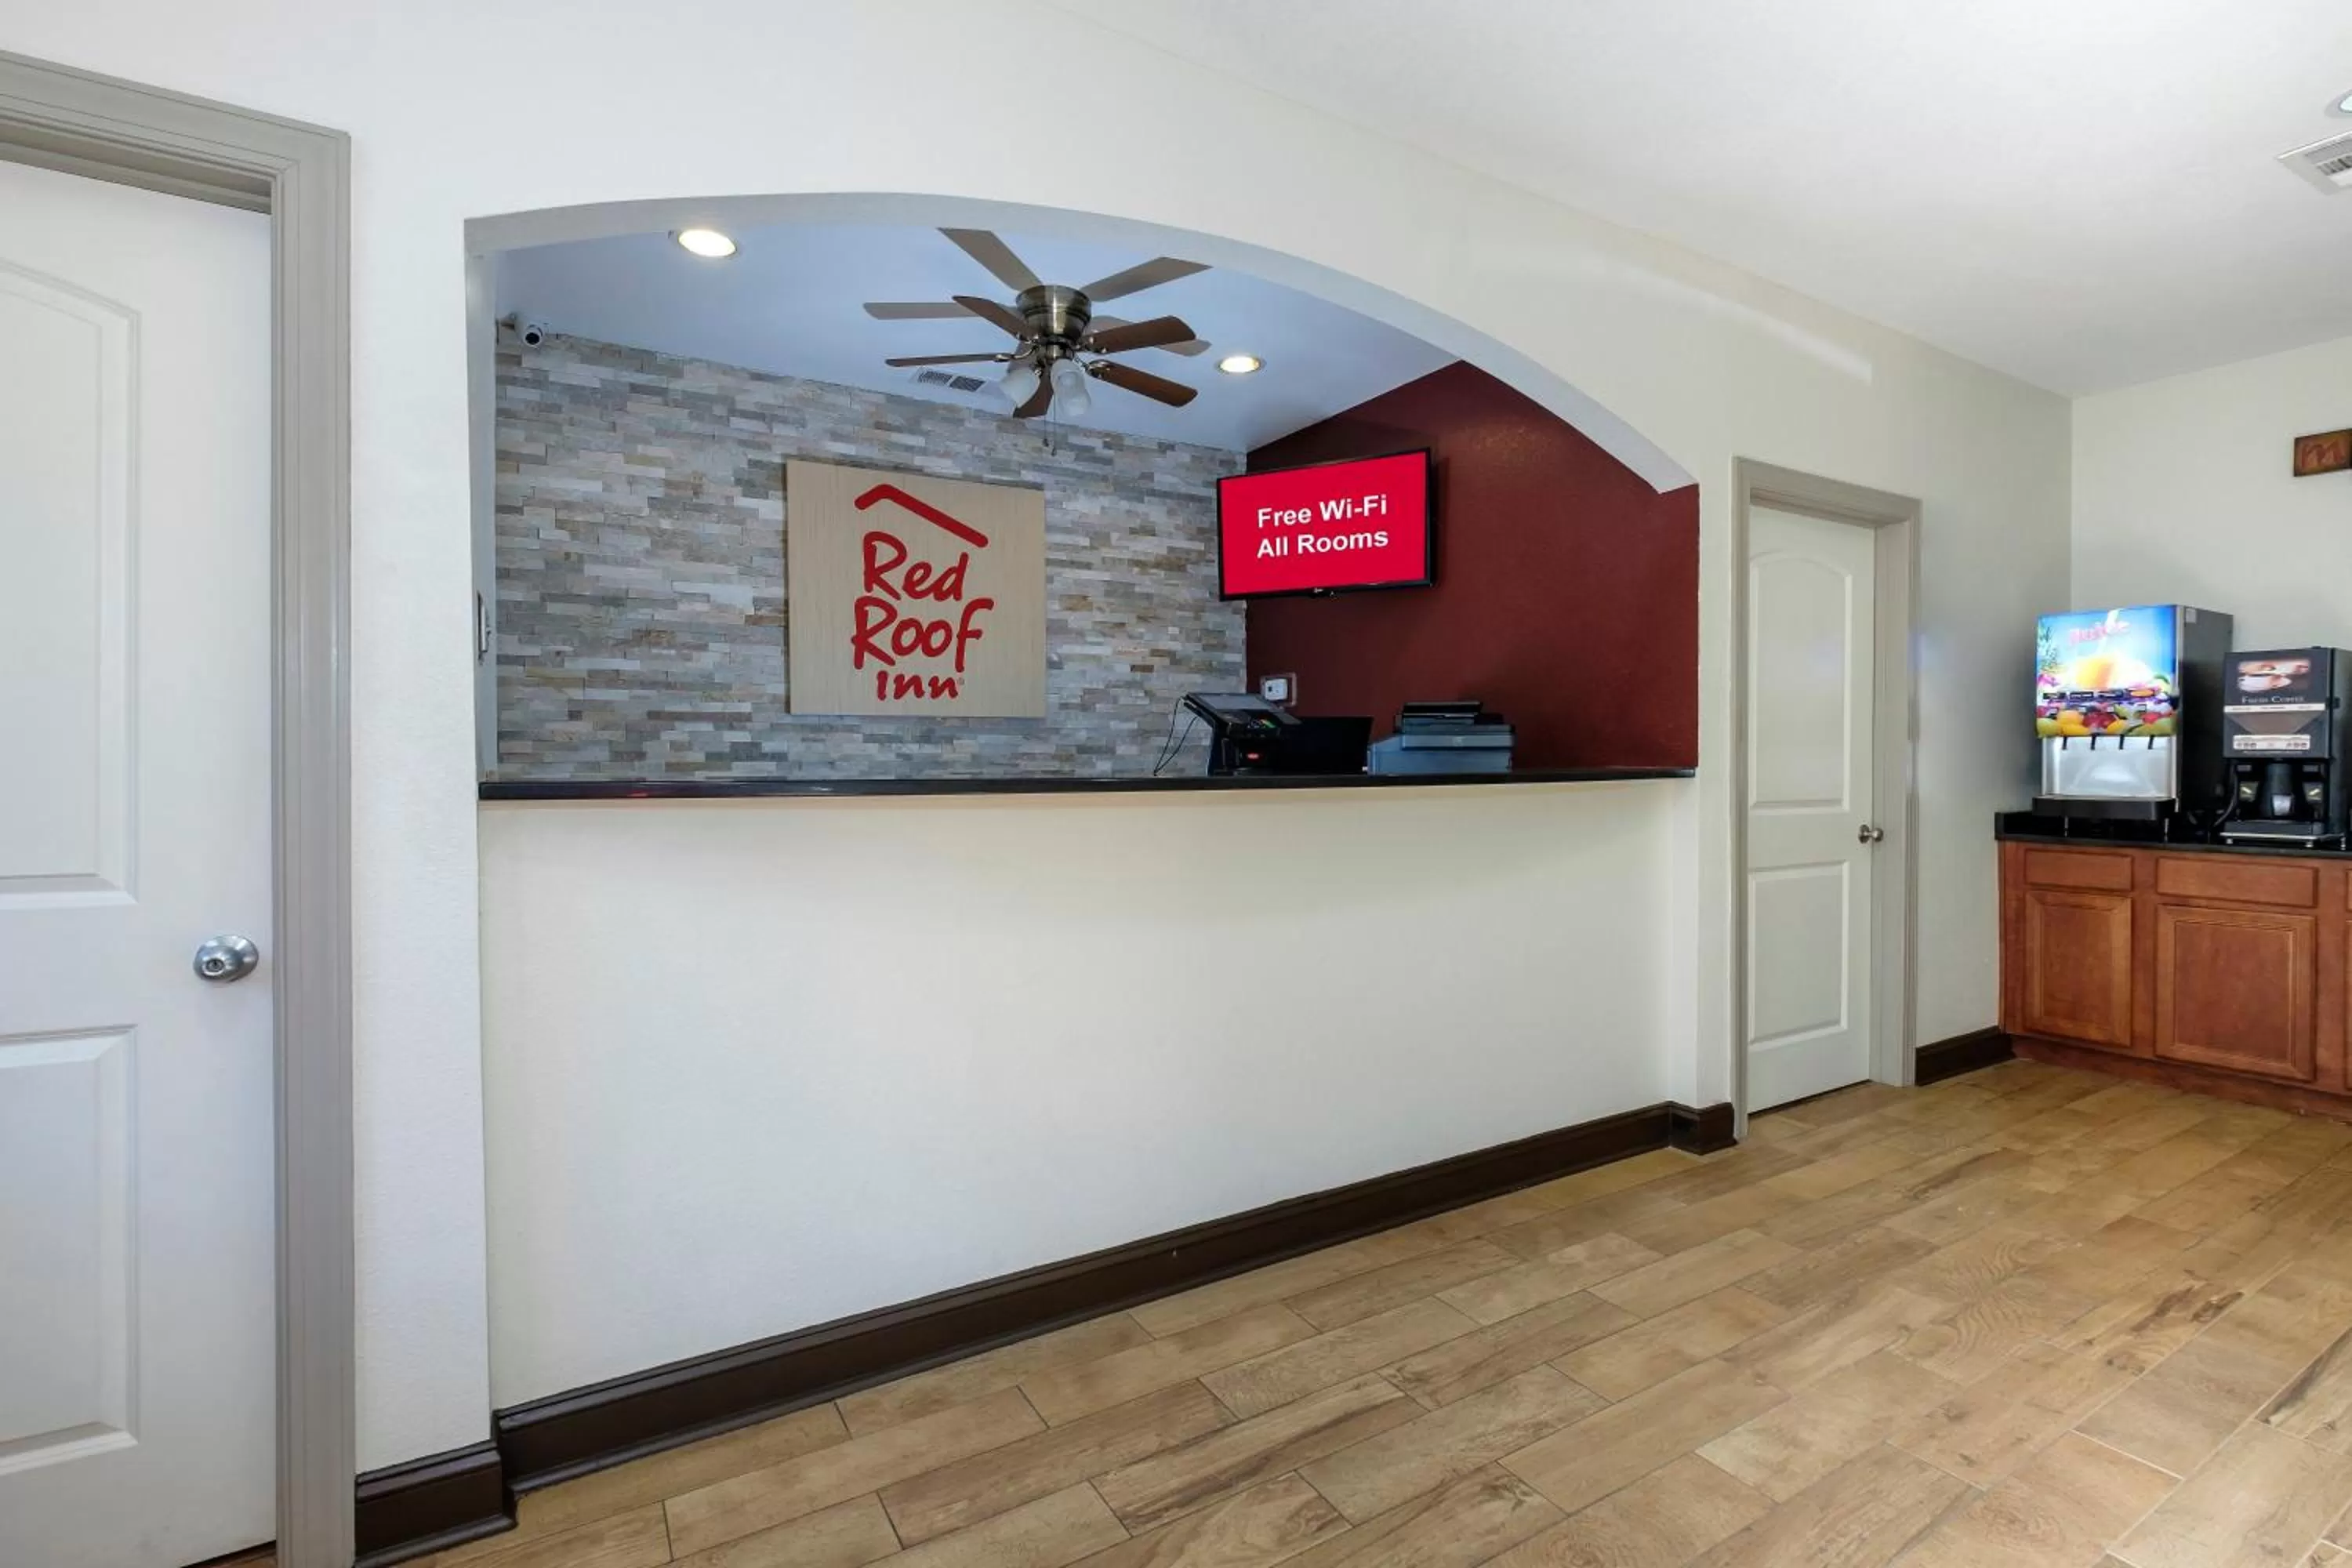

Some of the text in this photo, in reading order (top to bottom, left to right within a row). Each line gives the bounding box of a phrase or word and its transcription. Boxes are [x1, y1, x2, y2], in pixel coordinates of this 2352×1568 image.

[1257, 493, 1388, 528] Free Wi-Fi
[862, 531, 969, 601] Red
[1257, 530, 1389, 559] All Rooms
[851, 595, 995, 673] Roof
